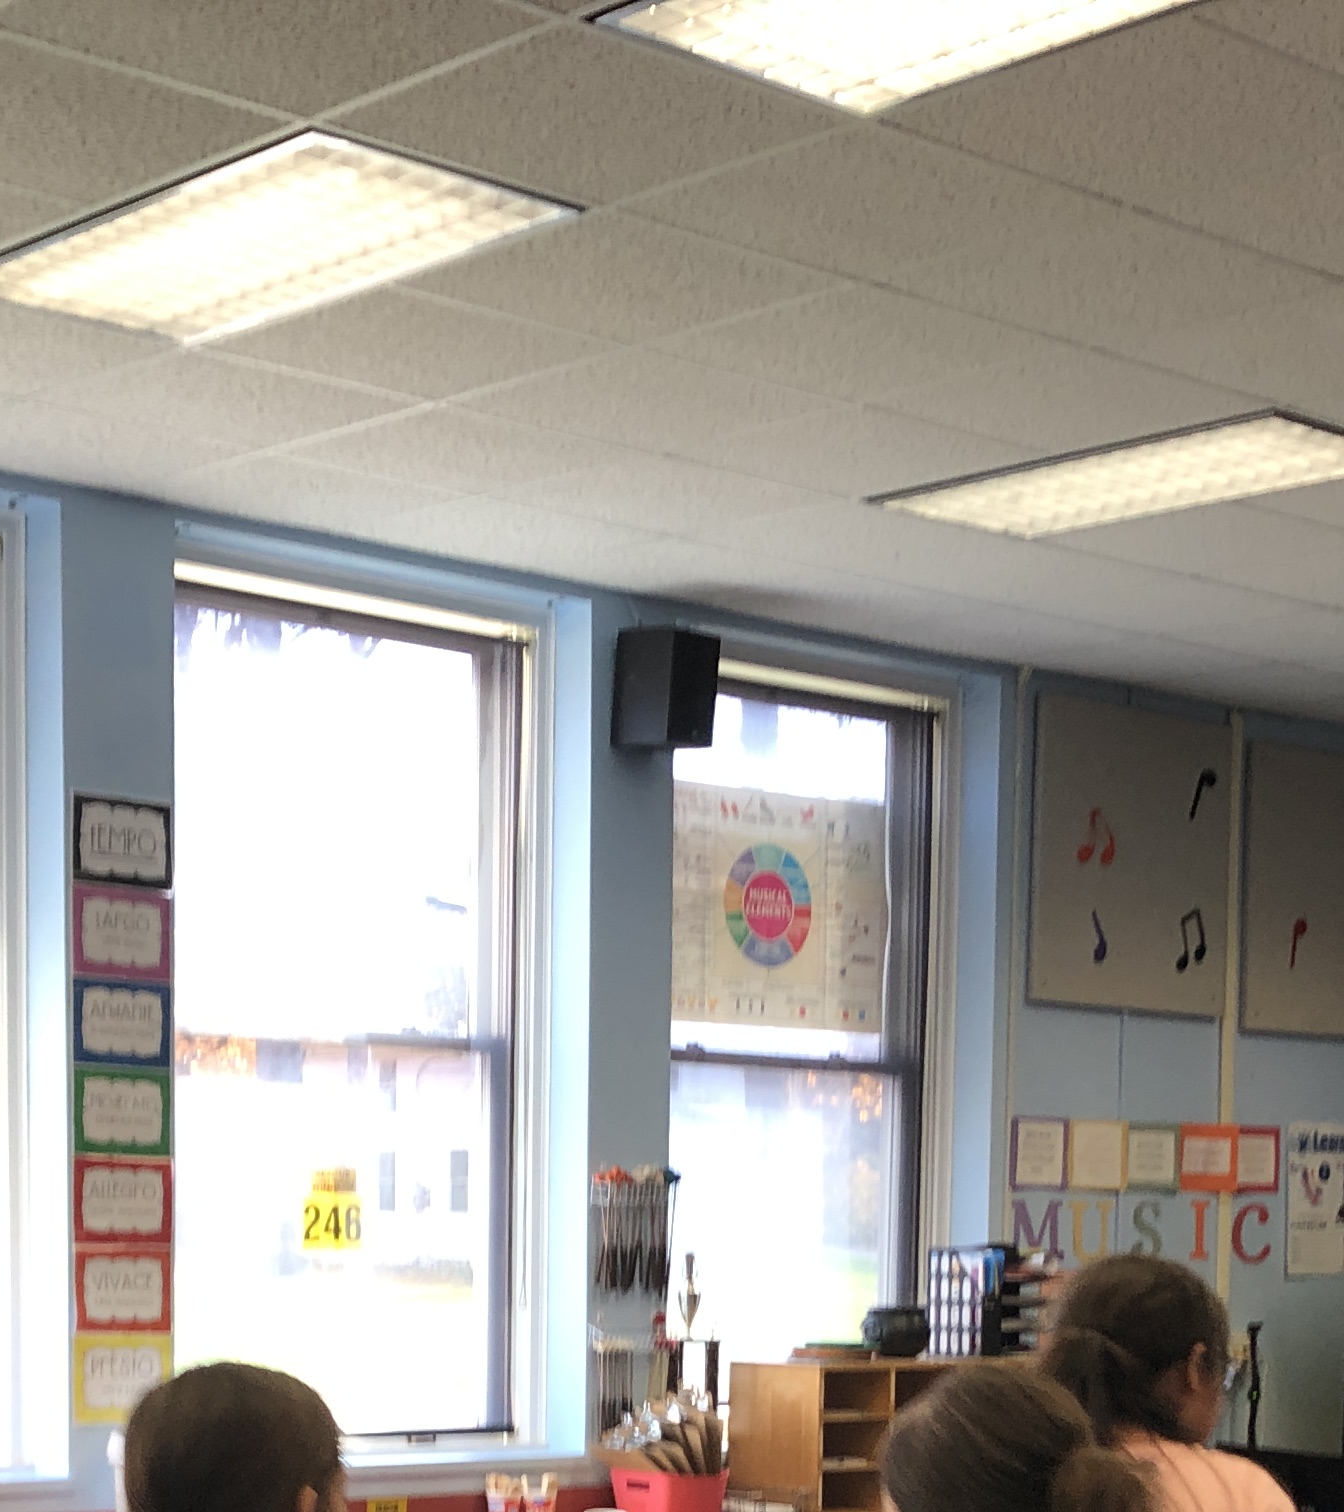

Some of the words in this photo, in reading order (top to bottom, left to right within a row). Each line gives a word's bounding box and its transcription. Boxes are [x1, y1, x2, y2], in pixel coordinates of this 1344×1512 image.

[90, 822, 156, 857] TEMPO
[303, 1203, 362, 1242] 246
[1012, 1198, 1271, 1266] MUSIC
